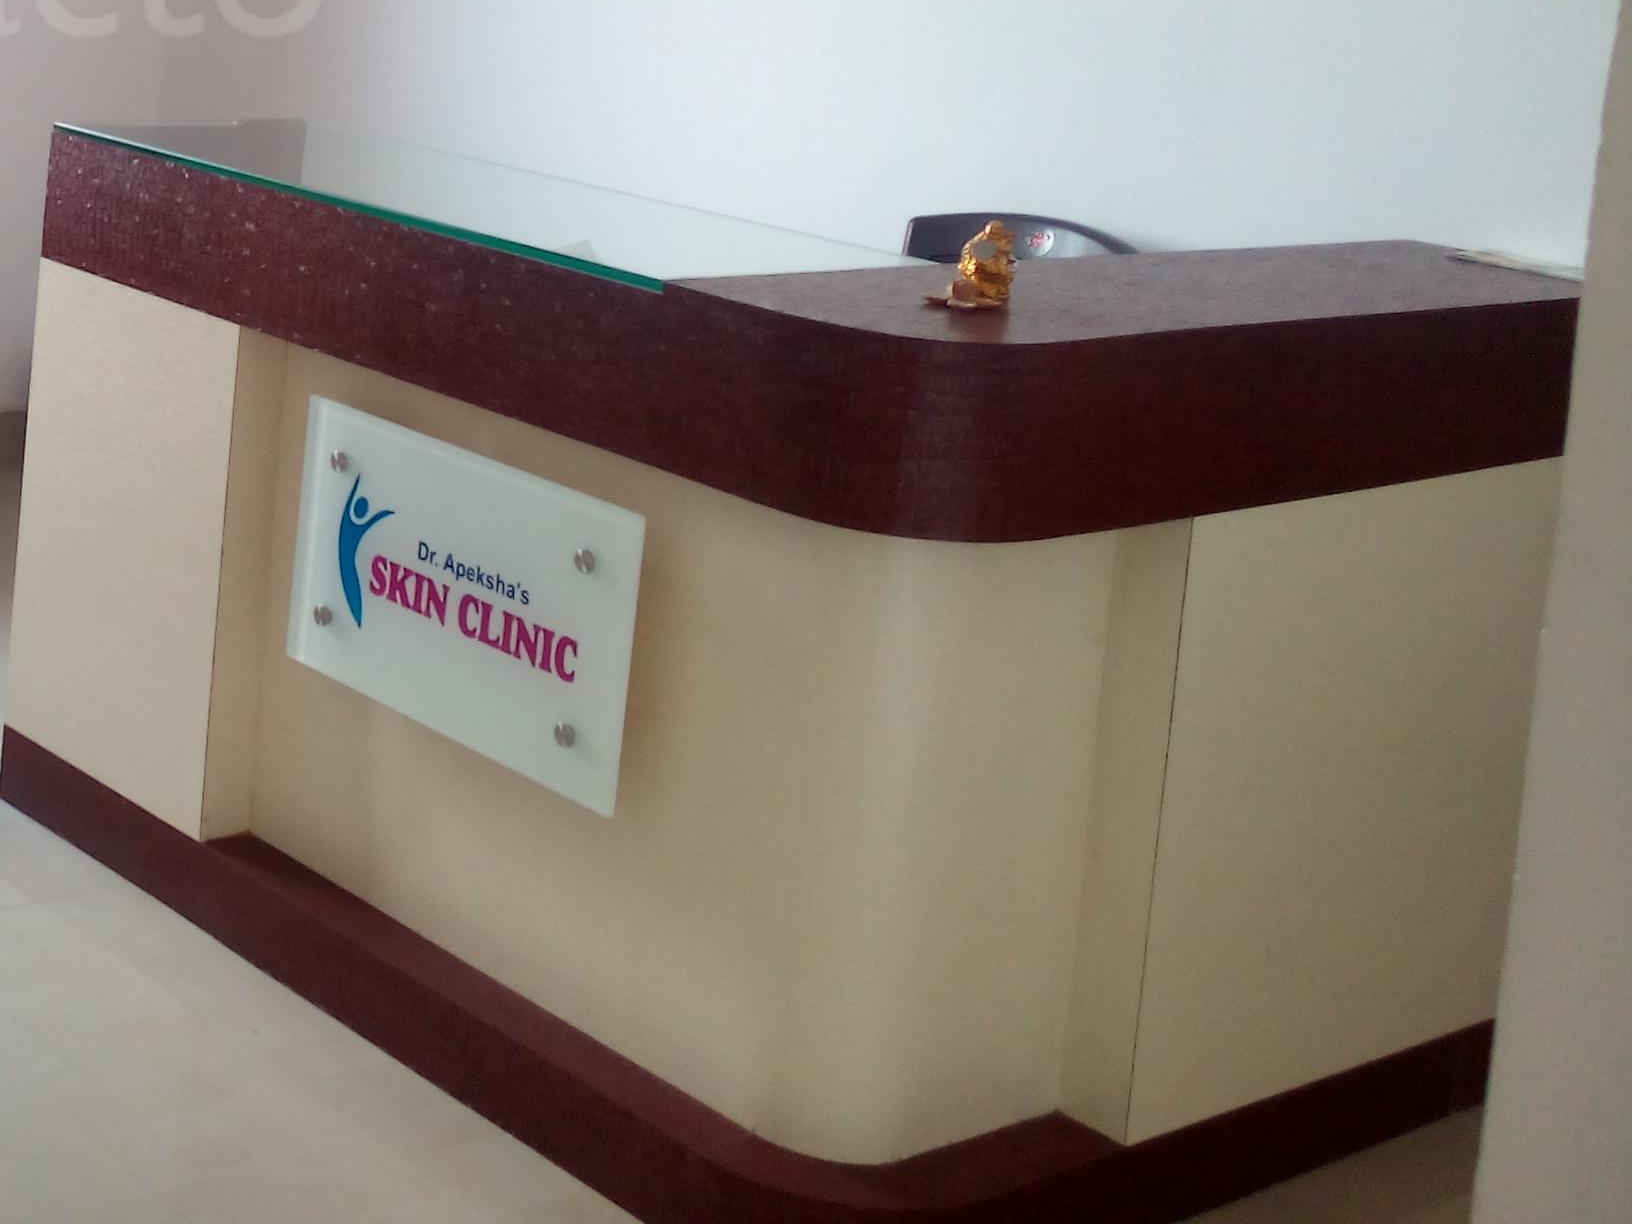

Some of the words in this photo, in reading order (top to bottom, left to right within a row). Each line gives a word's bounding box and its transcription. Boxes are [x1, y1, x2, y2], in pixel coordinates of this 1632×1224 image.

[369, 555, 450, 626] SKIN
[458, 594, 579, 683] CLINIC
[417, 541, 439, 568] Dr.
[443, 554, 530, 605] Apeksha's
